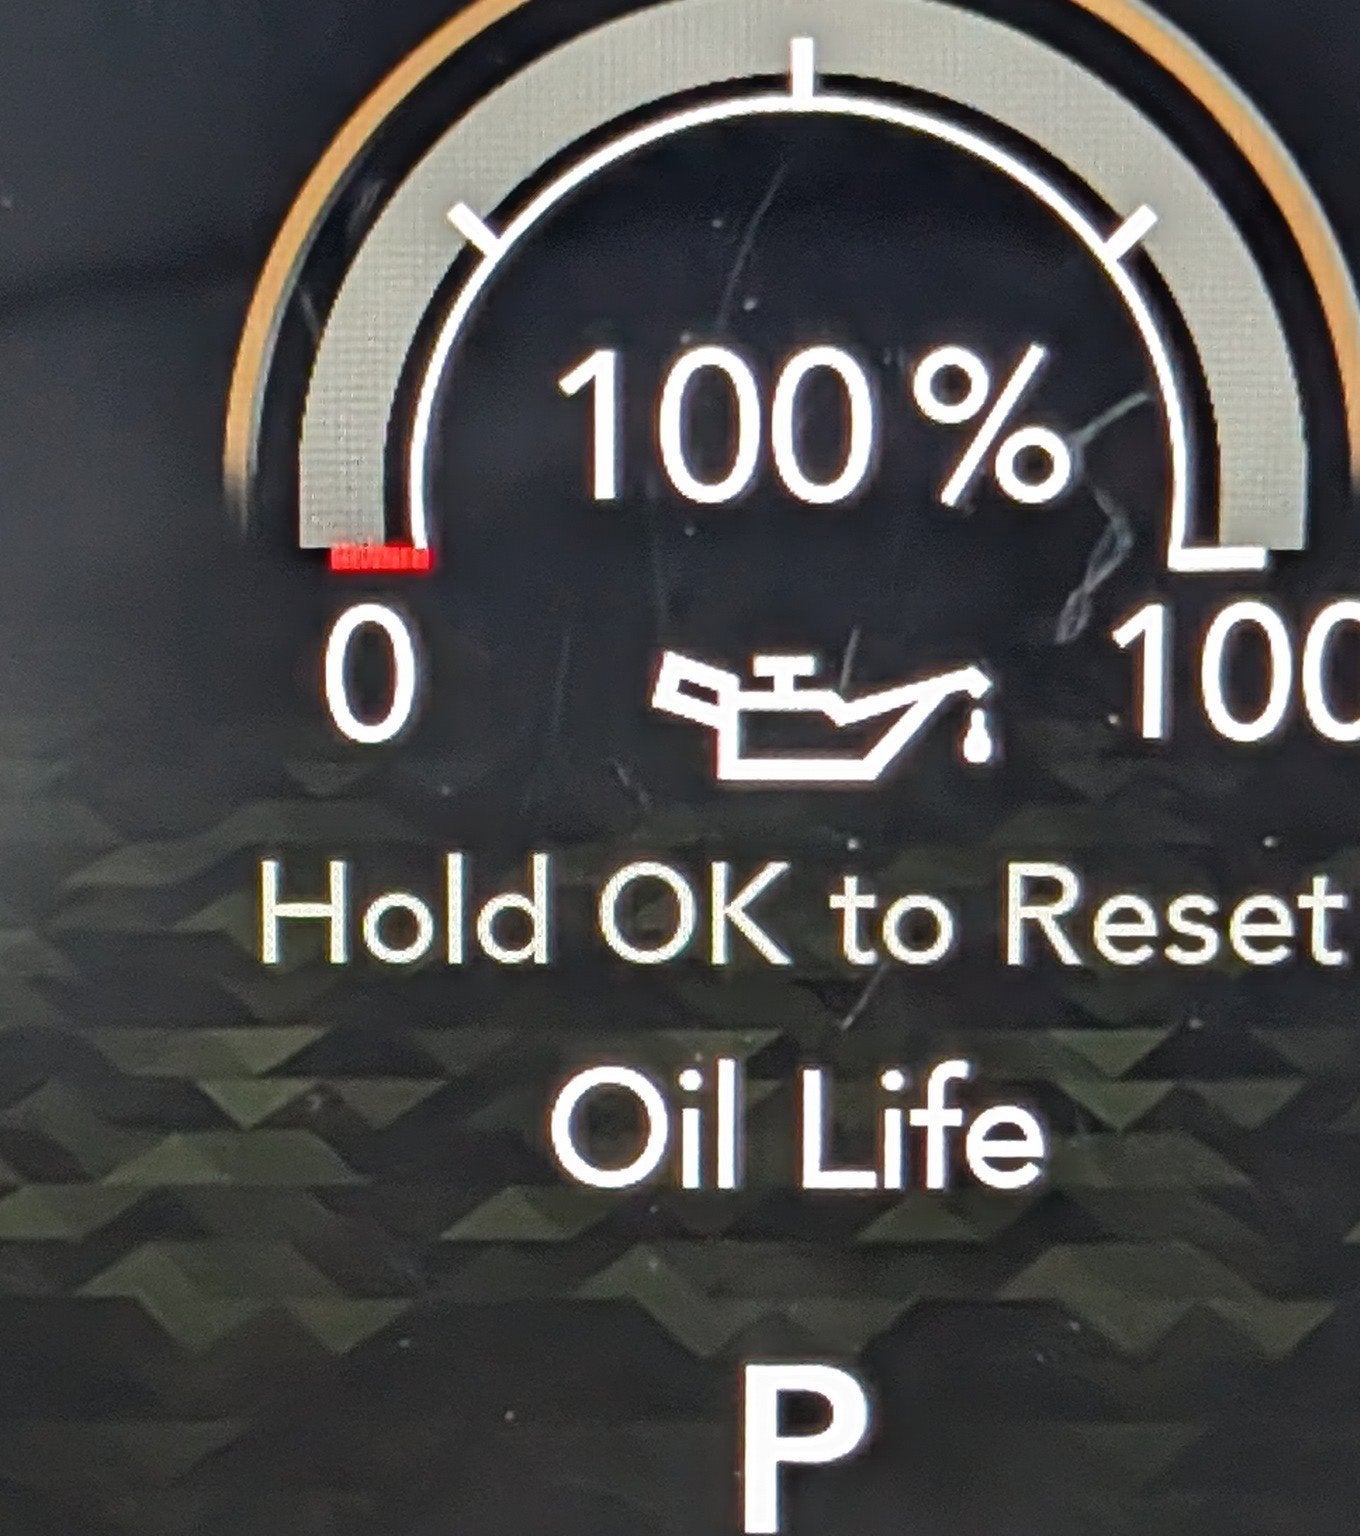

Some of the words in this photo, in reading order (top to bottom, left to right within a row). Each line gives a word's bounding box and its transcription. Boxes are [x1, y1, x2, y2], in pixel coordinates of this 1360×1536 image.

[558, 345, 875, 504] 100
[912, 344, 1073, 507] %
[325, 603, 417, 744] 0
[261, 851, 549, 966] Hold
[598, 860, 792, 966] OK
[829, 875, 954, 966] to
[1007, 861, 1348, 967] Reset
[550, 1058, 737, 1190] Oil
[801, 1059, 1047, 1190] Life
[744, 1363, 869, 1535] P
